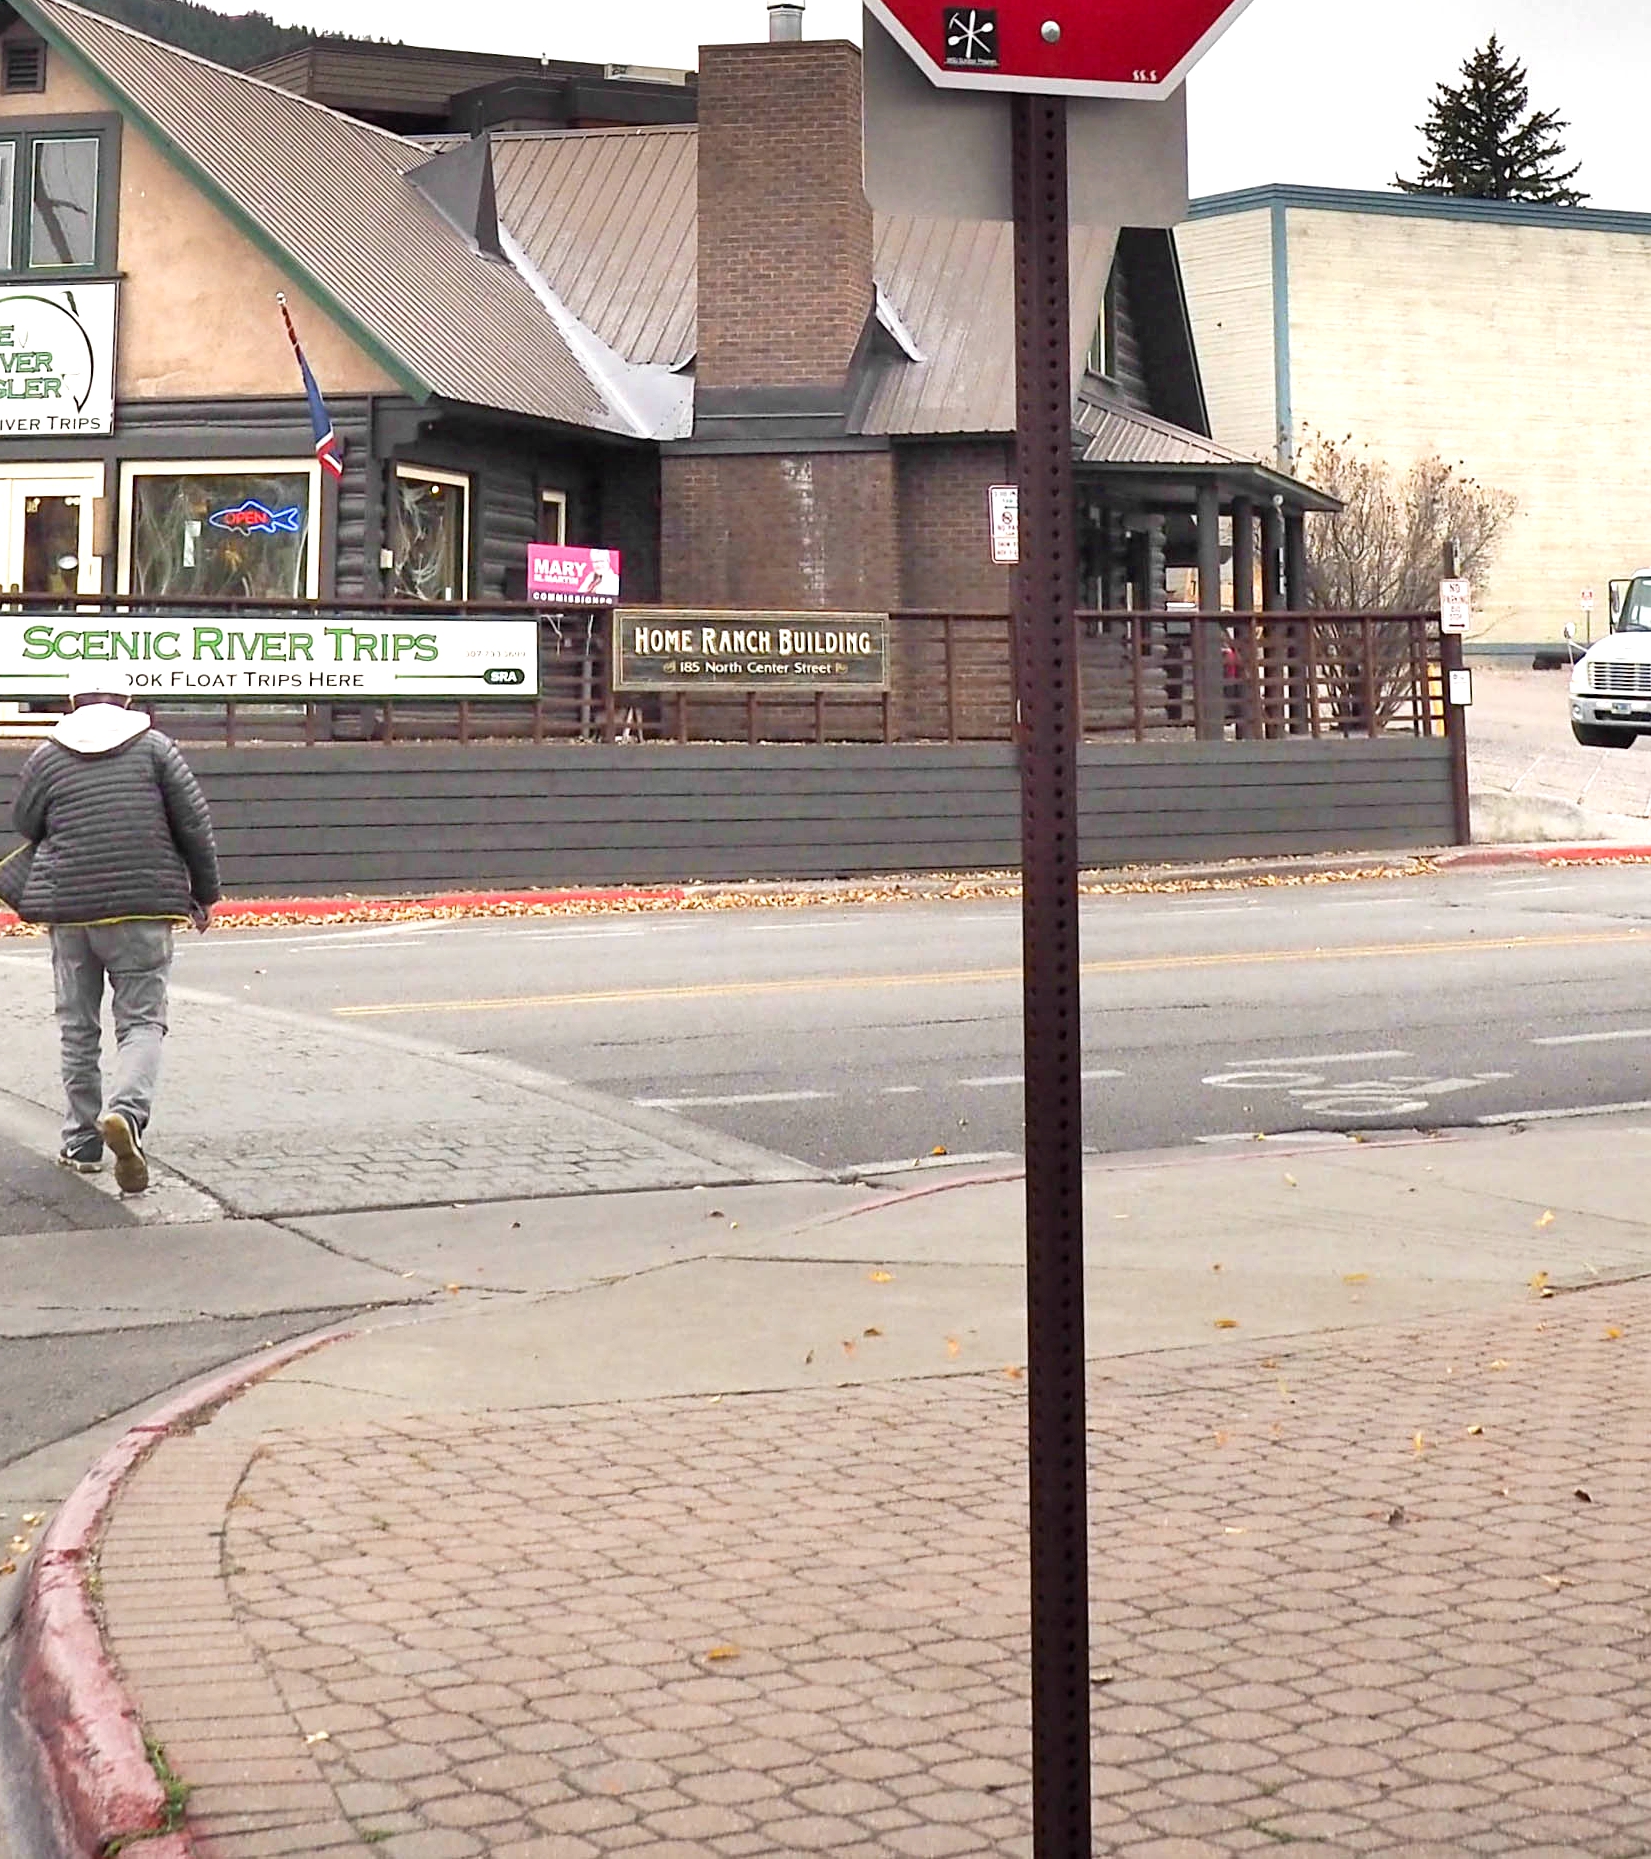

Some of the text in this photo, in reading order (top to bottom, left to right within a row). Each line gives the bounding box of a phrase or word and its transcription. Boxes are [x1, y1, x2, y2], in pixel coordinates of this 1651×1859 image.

[47, 416, 101, 430] TRIPS
[224, 509, 269, 526] OPEN
[533, 558, 587, 577] MARY
[1449, 584, 1461, 593] NO
[23, 626, 438, 661] SCENIC RIVER TRIPS
[634, 627, 871, 655] HOME RANCH BUILDING
[680, 661, 832, 675] 185 North Center Street
[125, 671, 364, 687] OK FLOAT TRIPS HERE
[490, 671, 518, 683] SRA
